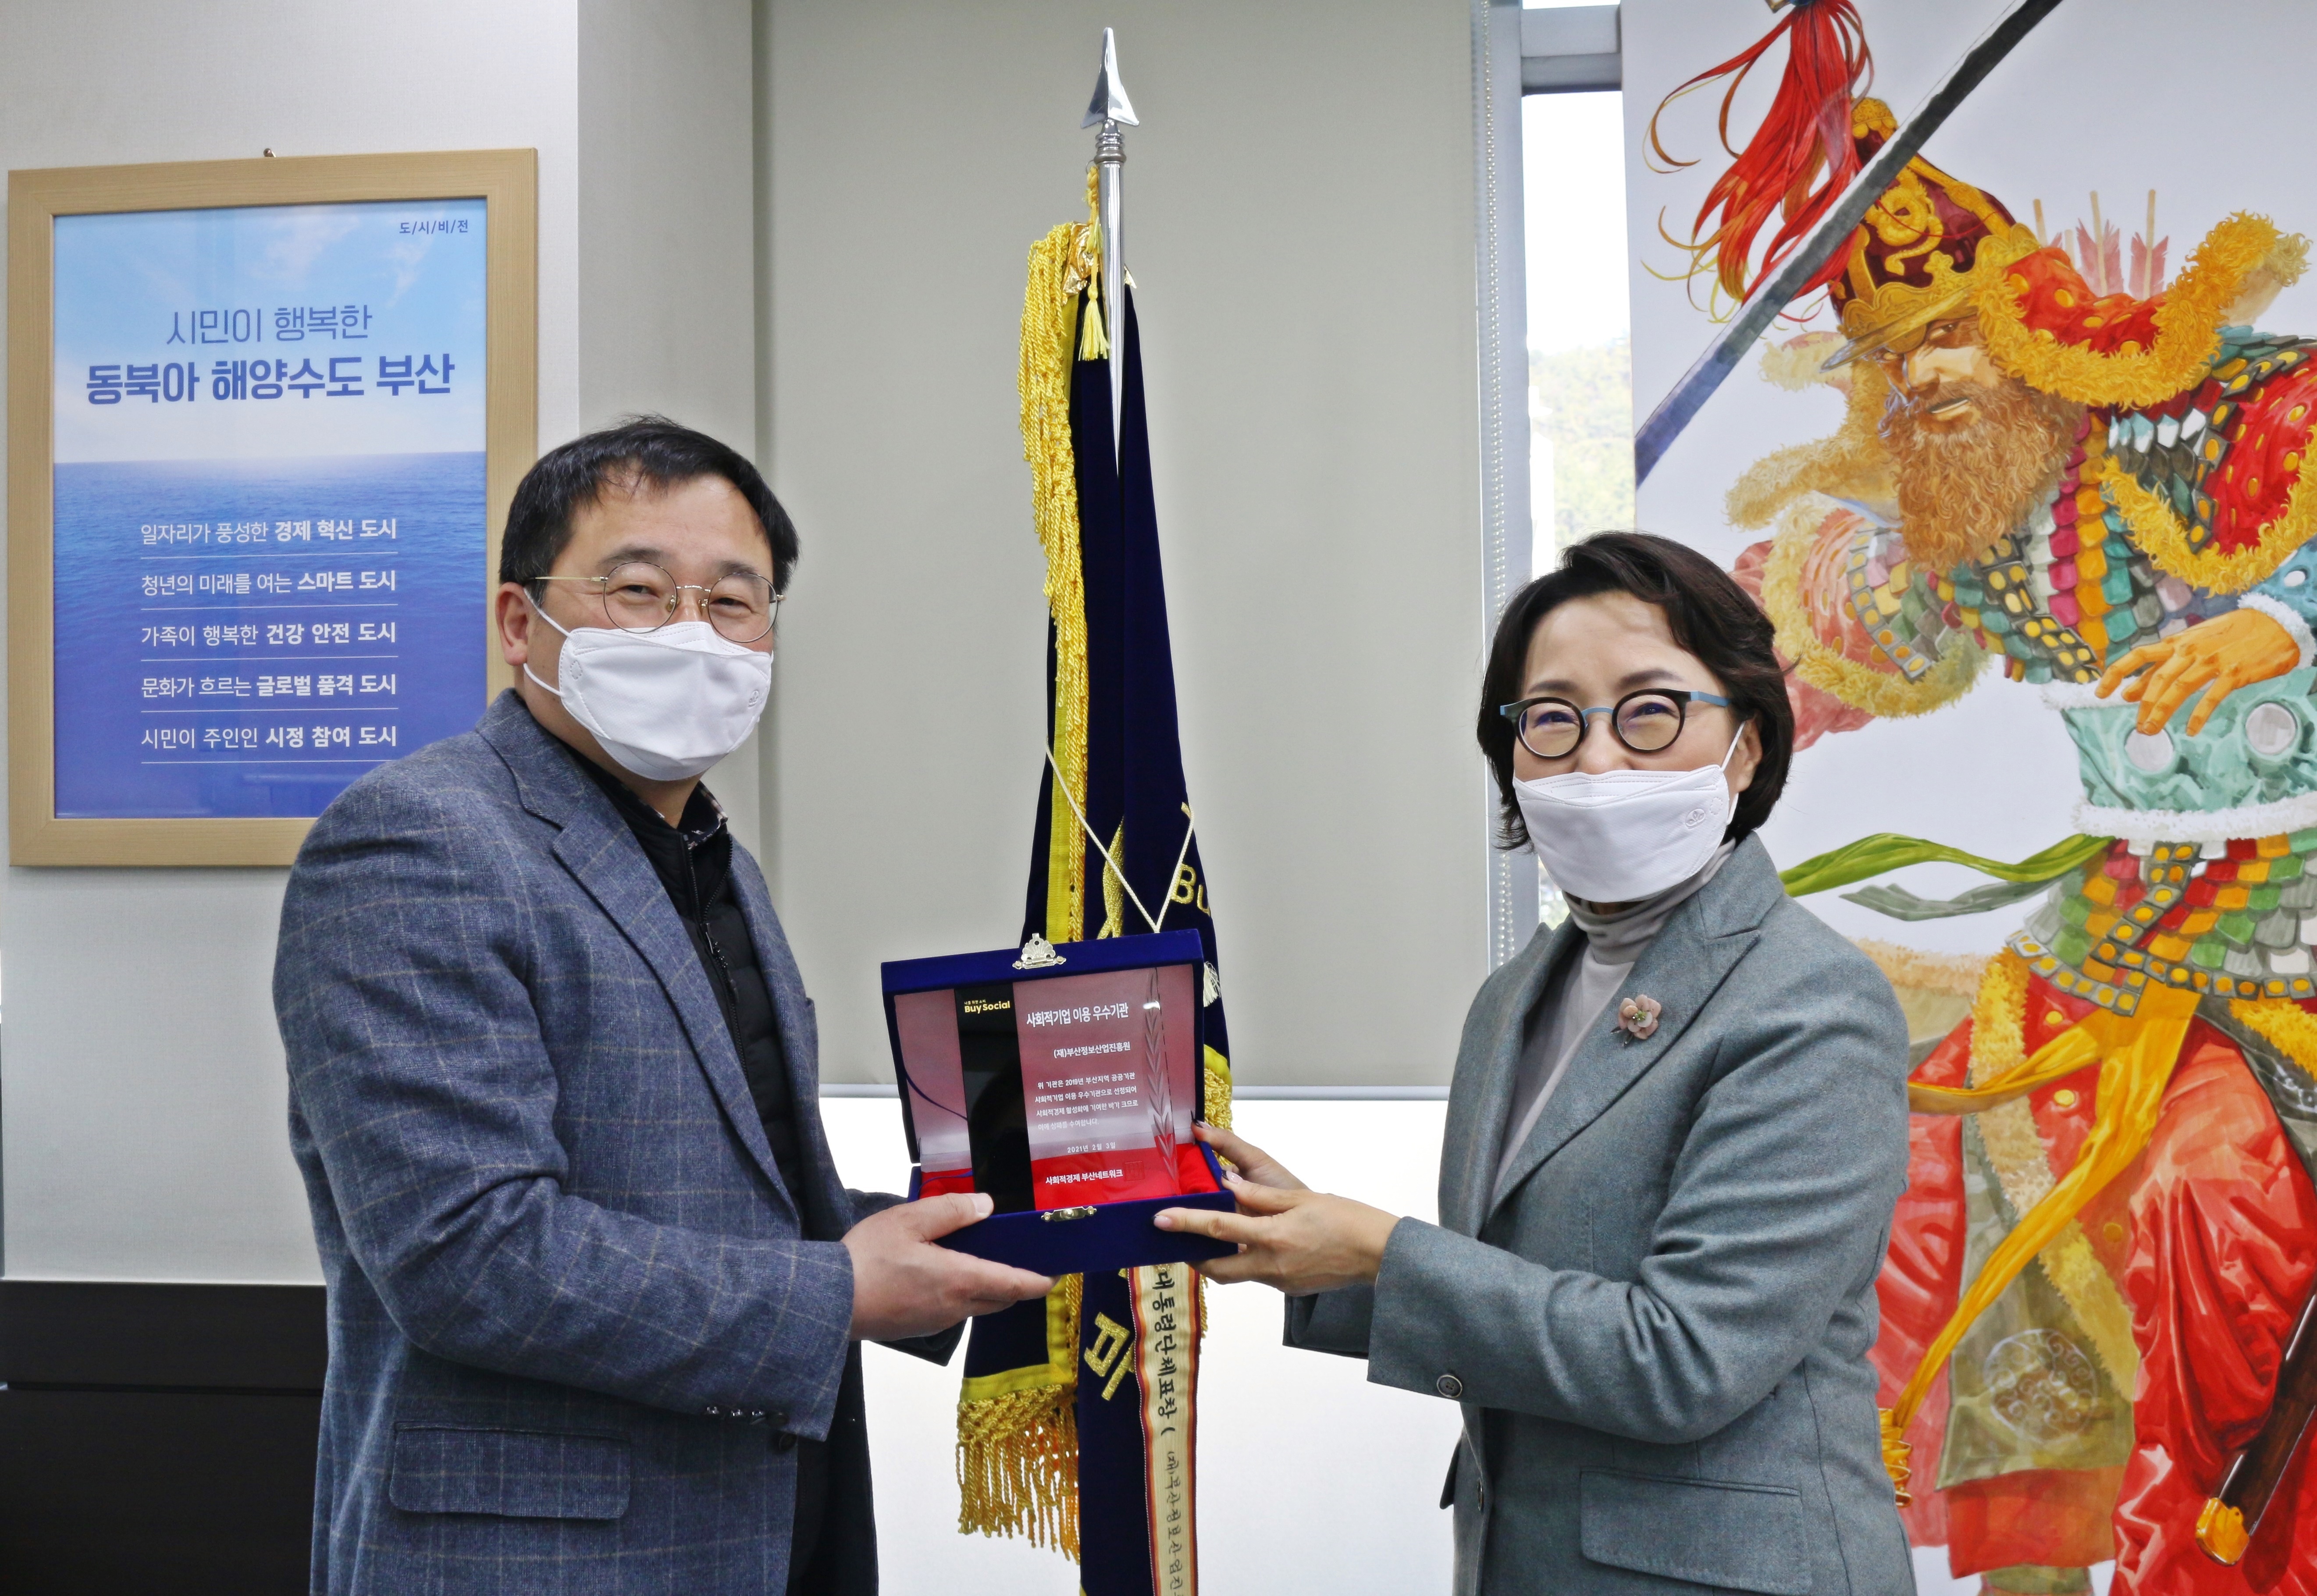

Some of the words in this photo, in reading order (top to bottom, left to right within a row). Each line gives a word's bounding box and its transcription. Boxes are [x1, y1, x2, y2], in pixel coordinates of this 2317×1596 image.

[399, 219, 469, 235] 도/시/비/전
[166, 309, 262, 345] 시민이
[274, 305, 373, 342] 행복한
[86, 362, 200, 405] 동북아
[211, 356, 364, 401] 해양수도
[377, 353, 455, 397] 부산
[141, 523, 210, 545] 일자리가
[215, 521, 267, 543] 풍성한
[275, 521, 311, 541] 경제
[317, 520, 352, 540] 혁신
[360, 519, 396, 539] 도시
[142, 575, 193, 596] 청년의
[199, 573, 251, 594] 미래를
[257, 573, 292, 594] 여는
[297, 572, 354, 592] 스마트
[359, 571, 396, 591] 도시
[142, 626, 195, 647] 가족이
[203, 625, 258, 647] 행복한
[266, 623, 303, 645] 건강
[312, 623, 350, 643] 안전
[358, 622, 396, 643] 도시
[142, 677, 194, 697] 문화가
[199, 676, 251, 697] 흐르는
[256, 675, 311, 696] 글로벌
[317, 675, 353, 696] 품격
[359, 674, 396, 695] 도시
[141, 728, 195, 749] 시민이
[203, 728, 258, 748] 주인인
[266, 727, 303, 748] 시정
[312, 727, 350, 747] 참여
[358, 726, 396, 746] 도시
[965, 1005, 982, 1013] Buy
[983, 1001, 1010, 1011] Social
[1026, 1009, 1071, 1027] 사회적기업
[1073, 1007, 1091, 1023] 이용
[1093, 1002, 1129, 1020] 우수기관
[1054, 1041, 1130, 1059] (재)부산정보산업진흥원
[1046, 1080, 1064, 1088] 기관은
[1086, 1075, 1109, 1084] 부산지역
[1111, 1072, 1135, 1081] 공공기관
[1035, 1094, 1064, 1103] 사회적기업
[1078, 1089, 1112, 1099] 우수기관으로
[1114, 1086, 1137, 1095] 선정되어
[1036, 1107, 1064, 1117] 사회적경제
[1066, 1105, 1089, 1114] 활성화에
[1046, 1173, 1080, 1185] 사회적경제
[1082, 1169, 1123, 1180] 부산네트워크
[1153, 1271, 1177, 1419] 대통령단체표창
[1165, 1451, 1183, 1596] (재)부산정보산업진
